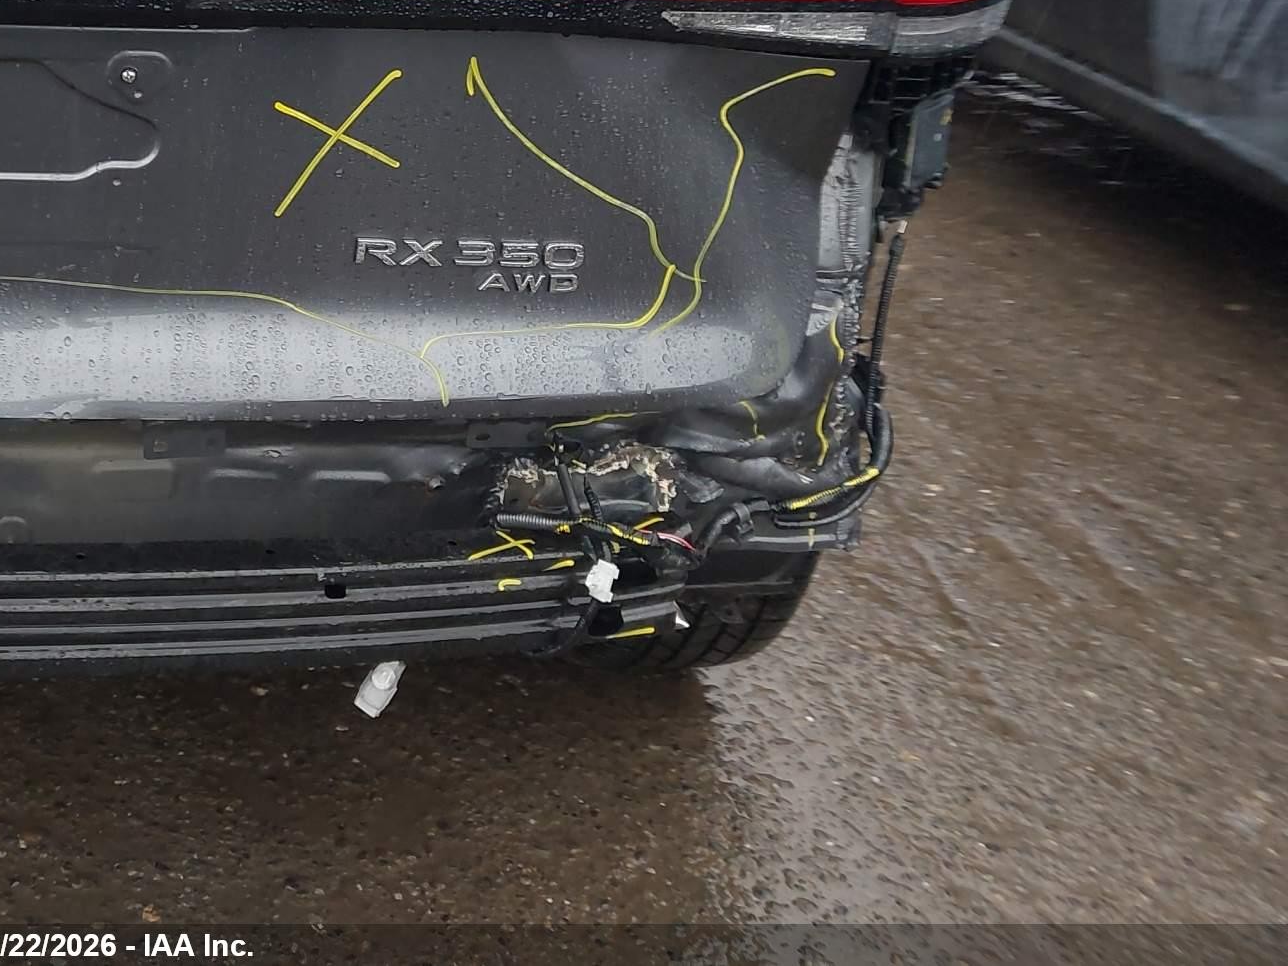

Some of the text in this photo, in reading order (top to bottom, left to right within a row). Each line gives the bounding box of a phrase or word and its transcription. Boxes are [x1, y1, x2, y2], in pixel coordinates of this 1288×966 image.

[354, 237, 585, 269] RX 350
[478, 272, 579, 293] AWD
